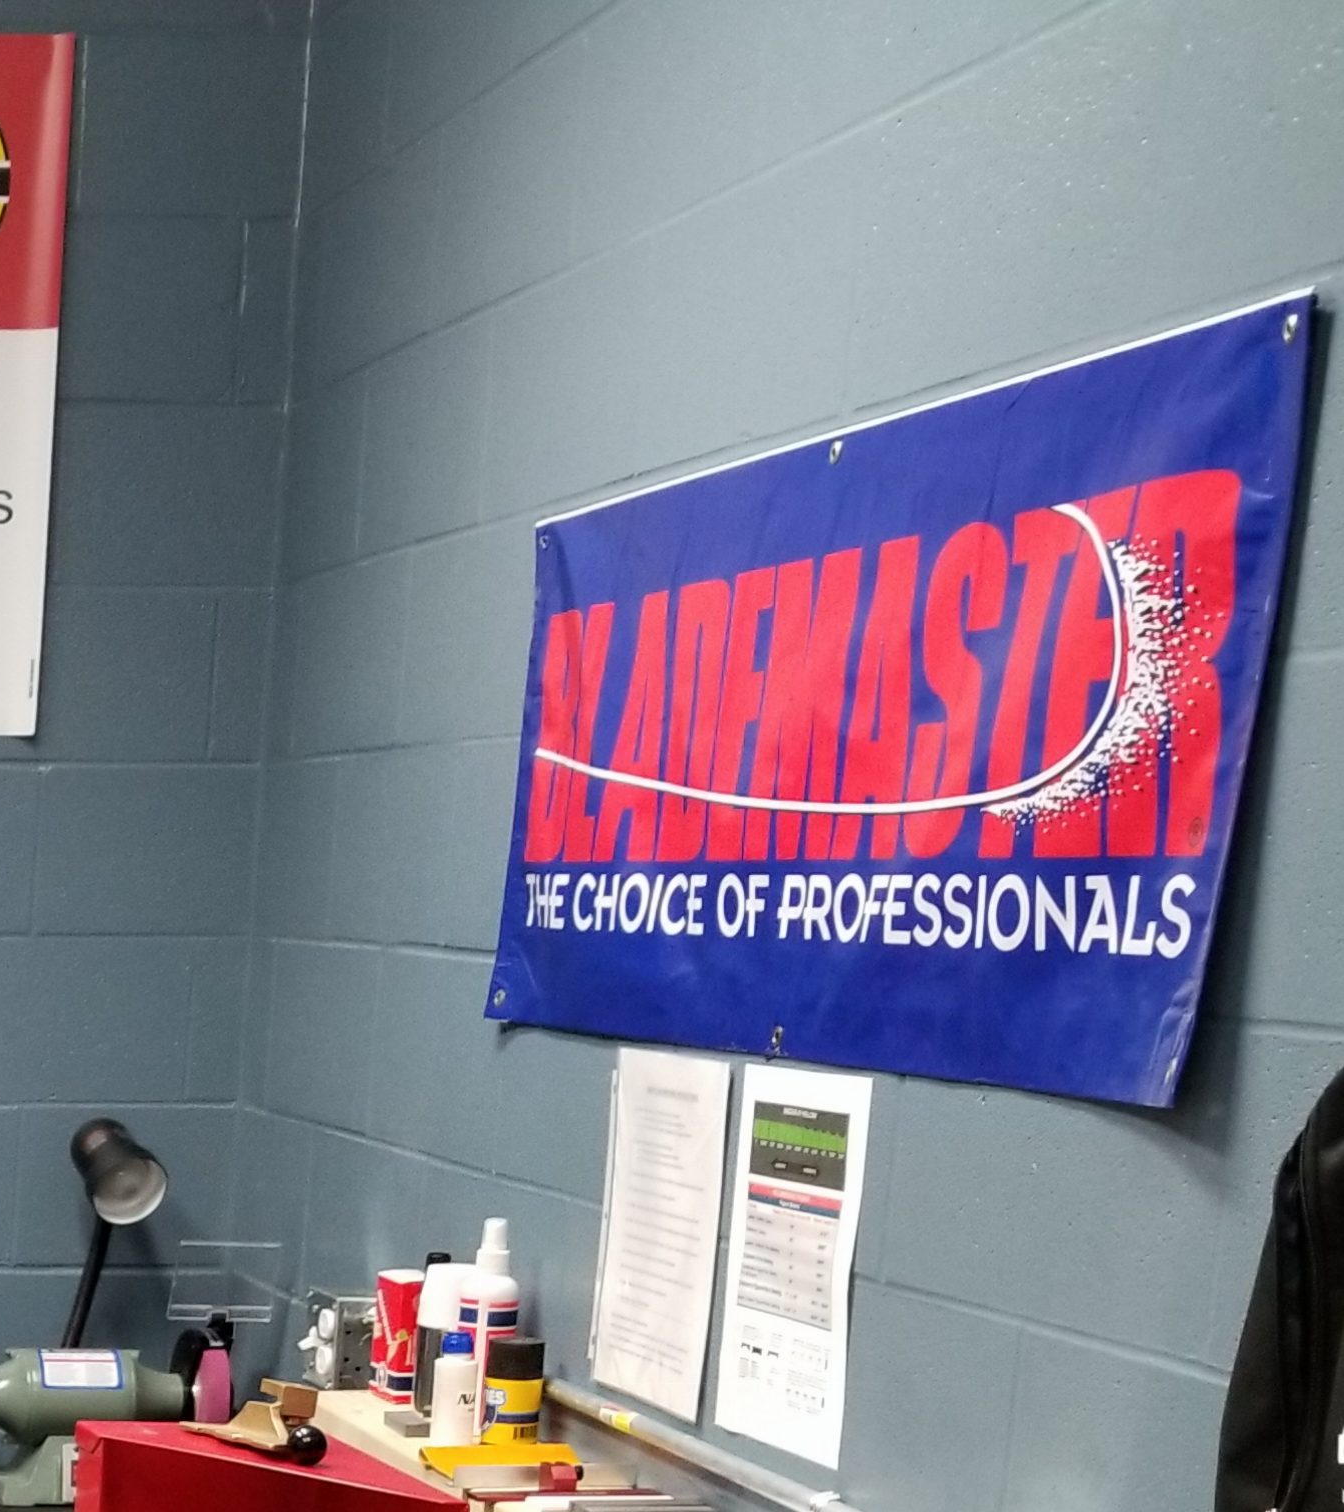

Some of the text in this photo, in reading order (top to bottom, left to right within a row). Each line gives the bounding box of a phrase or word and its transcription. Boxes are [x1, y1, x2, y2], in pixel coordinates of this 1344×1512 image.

[524, 469, 1242, 863] BLADEMASTER
[525, 872, 1197, 960] THE CHOICE OF PROFESSIONALS
